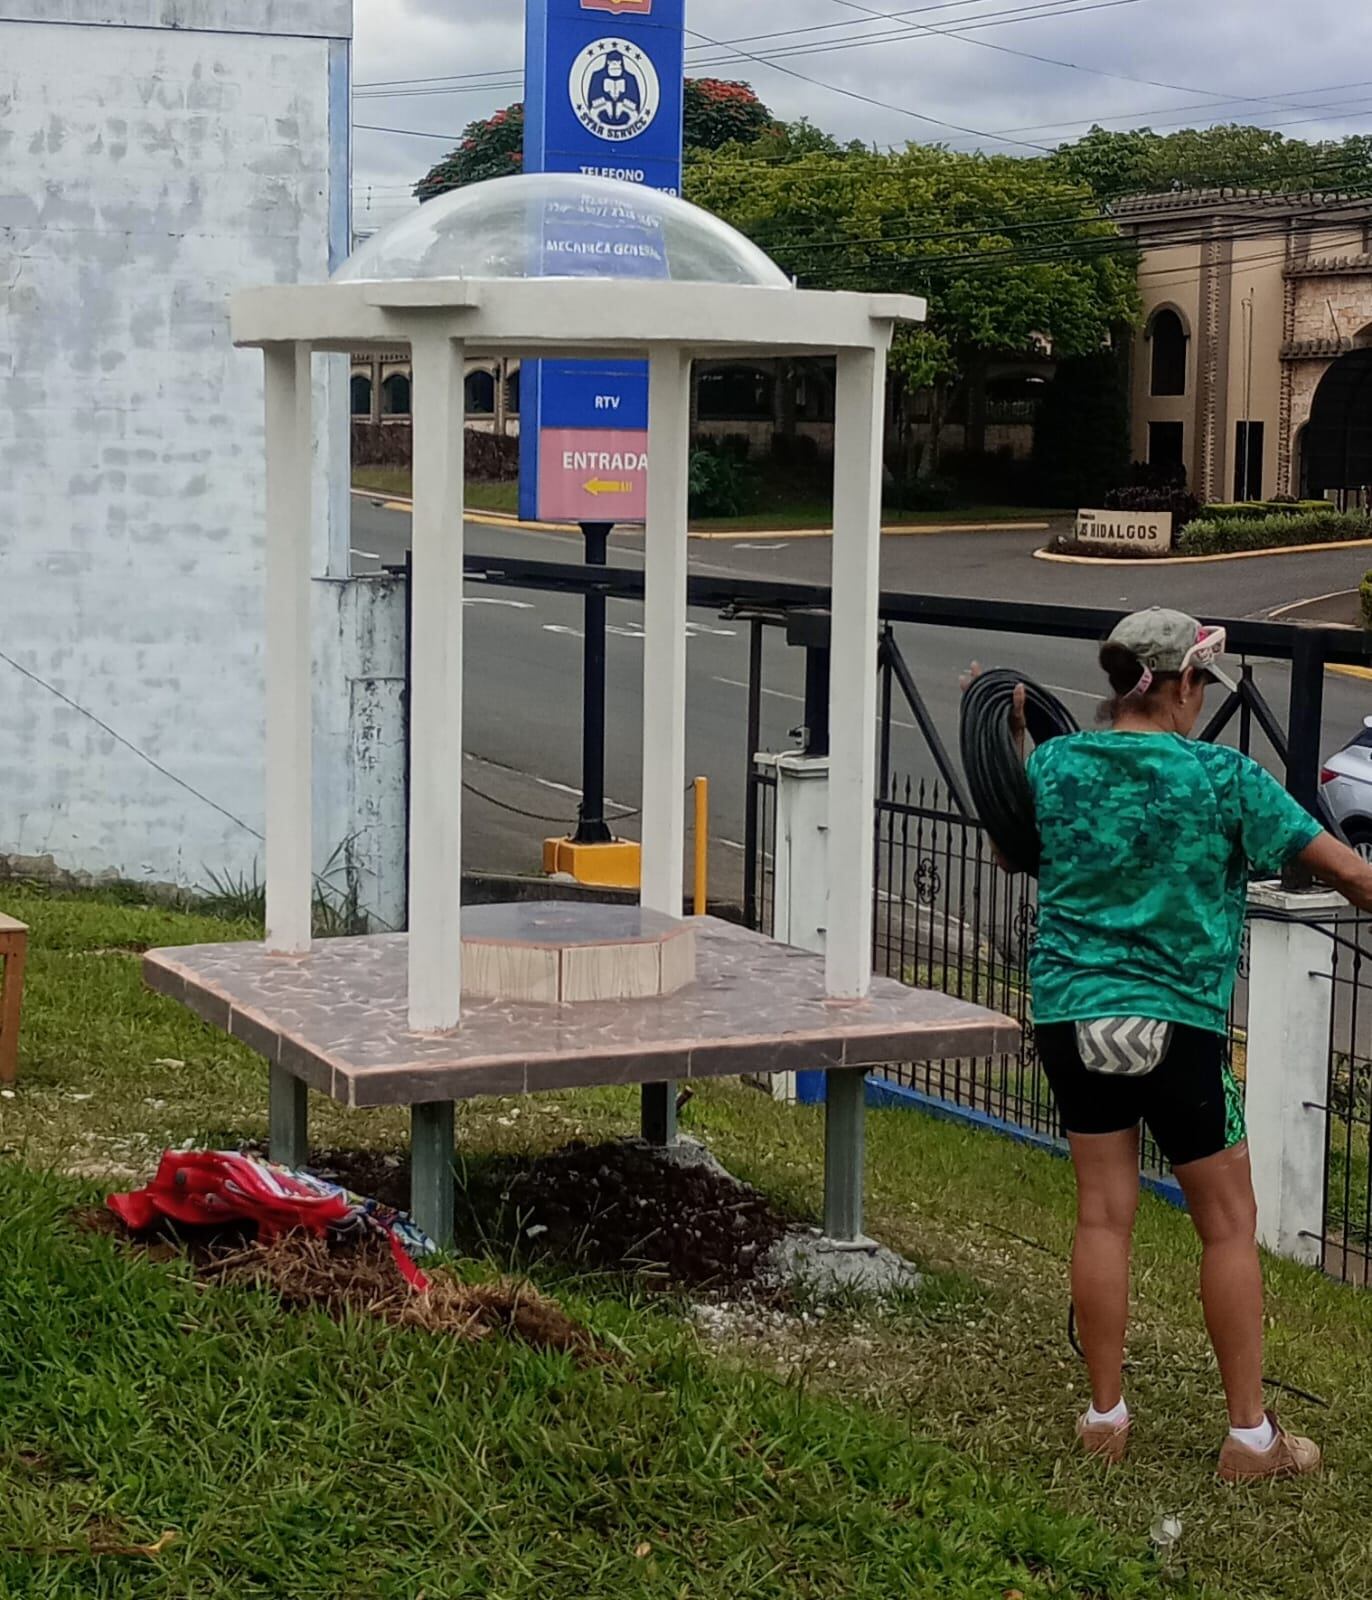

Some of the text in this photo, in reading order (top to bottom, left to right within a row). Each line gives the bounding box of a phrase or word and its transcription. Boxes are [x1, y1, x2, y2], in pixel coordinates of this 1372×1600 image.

[580, 112, 647, 138] STAR SERVICE
[580, 166, 644, 181] TELEFONO
[595, 395, 620, 409] RTV
[563, 451, 648, 470] ENTRADA
[1090, 522, 1158, 540] HIDALGOS
